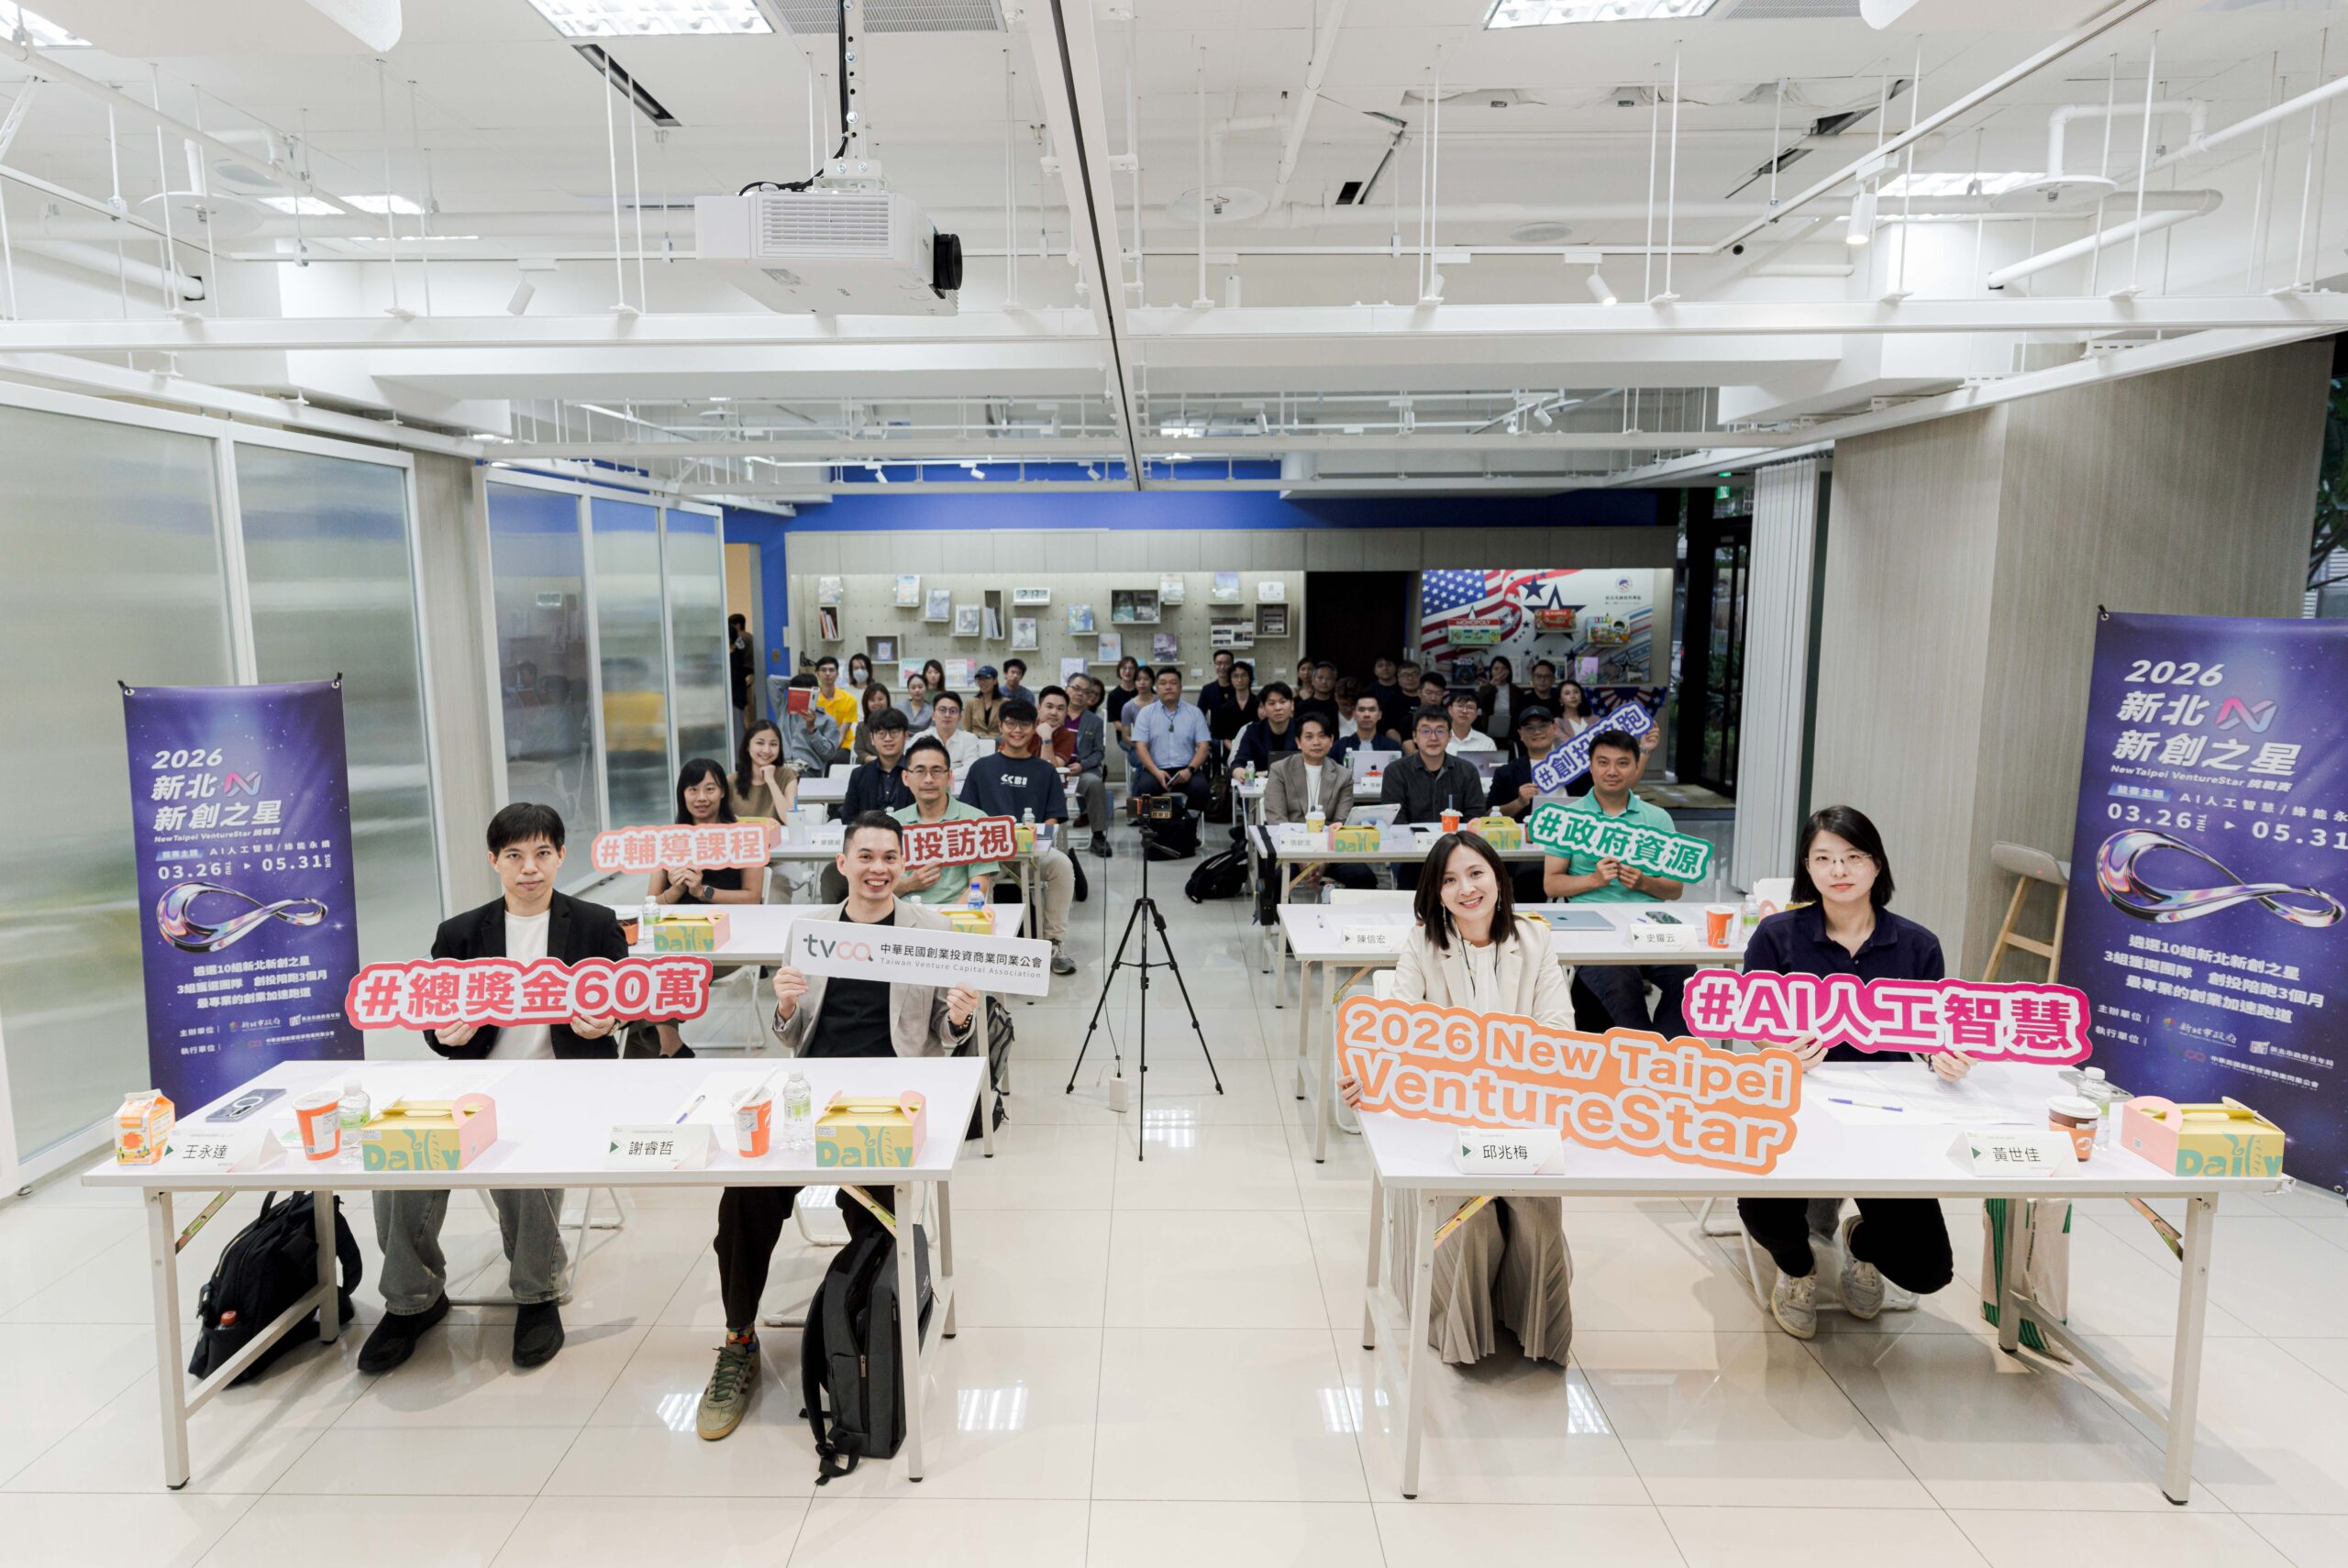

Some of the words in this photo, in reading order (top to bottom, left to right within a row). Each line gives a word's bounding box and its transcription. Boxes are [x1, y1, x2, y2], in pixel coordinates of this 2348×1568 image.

[2124, 659, 2226, 687] 2026
[2117, 690, 2211, 726] 新北
[151, 748, 224, 769] 2026
[1538, 709, 1646, 787] #創投跑
[2111, 730, 2302, 777] 新創之星
[151, 773, 218, 801] 新北
[2172, 771, 2246, 788] VentureStar
[153, 800, 282, 832] 新創之星
[2108, 802, 2192, 829] 03.26
[2252, 821, 2348, 851] 05.31
[201, 830, 251, 841] VentureStar
[601, 830, 761, 865] #輔導課程
[1537, 811, 1704, 875] #政府資源
[158, 862, 222, 880] 03.26
[261, 855, 322, 872] 05.31
[880, 943, 1043, 968] 中華民國創業投資商業同業公會
[880, 957, 912, 967] Taiwan
[914, 960, 950, 970] Venture
[953, 964, 986, 975] Capital
[989, 967, 1042, 979] Association
[361, 967, 701, 1018] #總獎金60萬
[1697, 982, 2073, 1051] #AI人工智慧
[1351, 1008, 1471, 1053] 2026
[1492, 1029, 1599, 1074] New
[1617, 1043, 1785, 1102] Taipei
[1352, 1055, 1778, 1159] VentureStar
[183, 1144, 228, 1159] 王永達
[362, 1127, 460, 1172] Daily
[628, 1141, 674, 1156] 謝睿哲
[815, 1123, 913, 1167] Daily
[1482, 1144, 1529, 1160] 邱兆梅
[1992, 1146, 2042, 1162] 黃世佳
[2175, 1132, 2283, 1177] Daily
